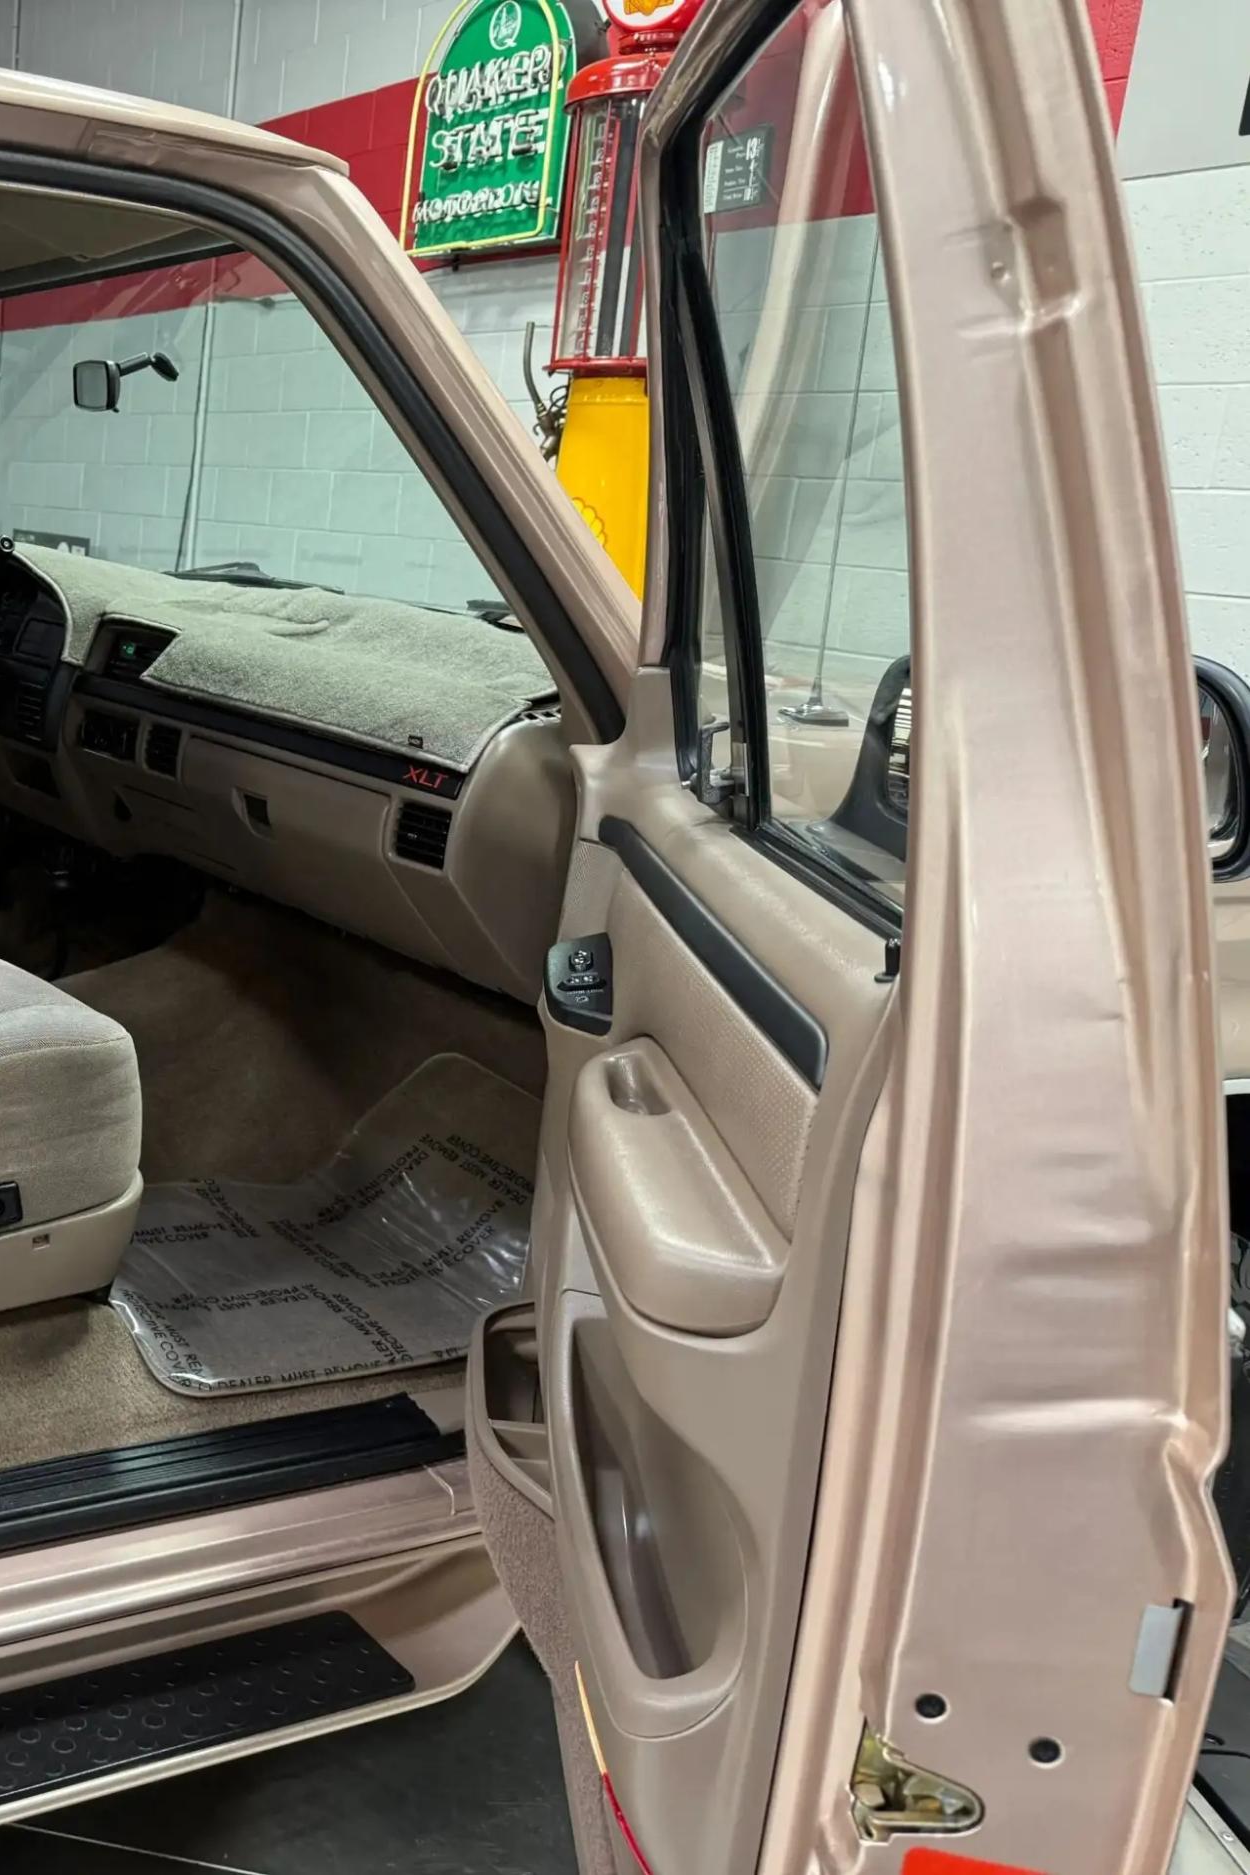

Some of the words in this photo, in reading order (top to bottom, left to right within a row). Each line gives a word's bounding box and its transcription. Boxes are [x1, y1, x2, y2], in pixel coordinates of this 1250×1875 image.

[425, 43, 565, 122] QUAKER
[430, 108, 550, 171] STATE
[412, 189, 493, 224] MOTOR
[499, 180, 552, 210] OIL
[403, 765, 448, 789] XLT
[164, 1231, 209, 1243] COVER
[456, 1199, 507, 1245] REMOVE
[452, 1225, 496, 1263] COVER
[302, 1284, 346, 1314] REMOVE
[331, 1293, 371, 1320] COVER
[165, 1323, 191, 1347] MUST
[342, 1314, 376, 1336] MUST
[364, 1319, 415, 1363] OTECTIVE
[371, 1339, 398, 1365] ALER
[160, 1341, 192, 1387] COVER
[218, 1375, 272, 1388] DEALER
[280, 1370, 316, 1383] MUST
